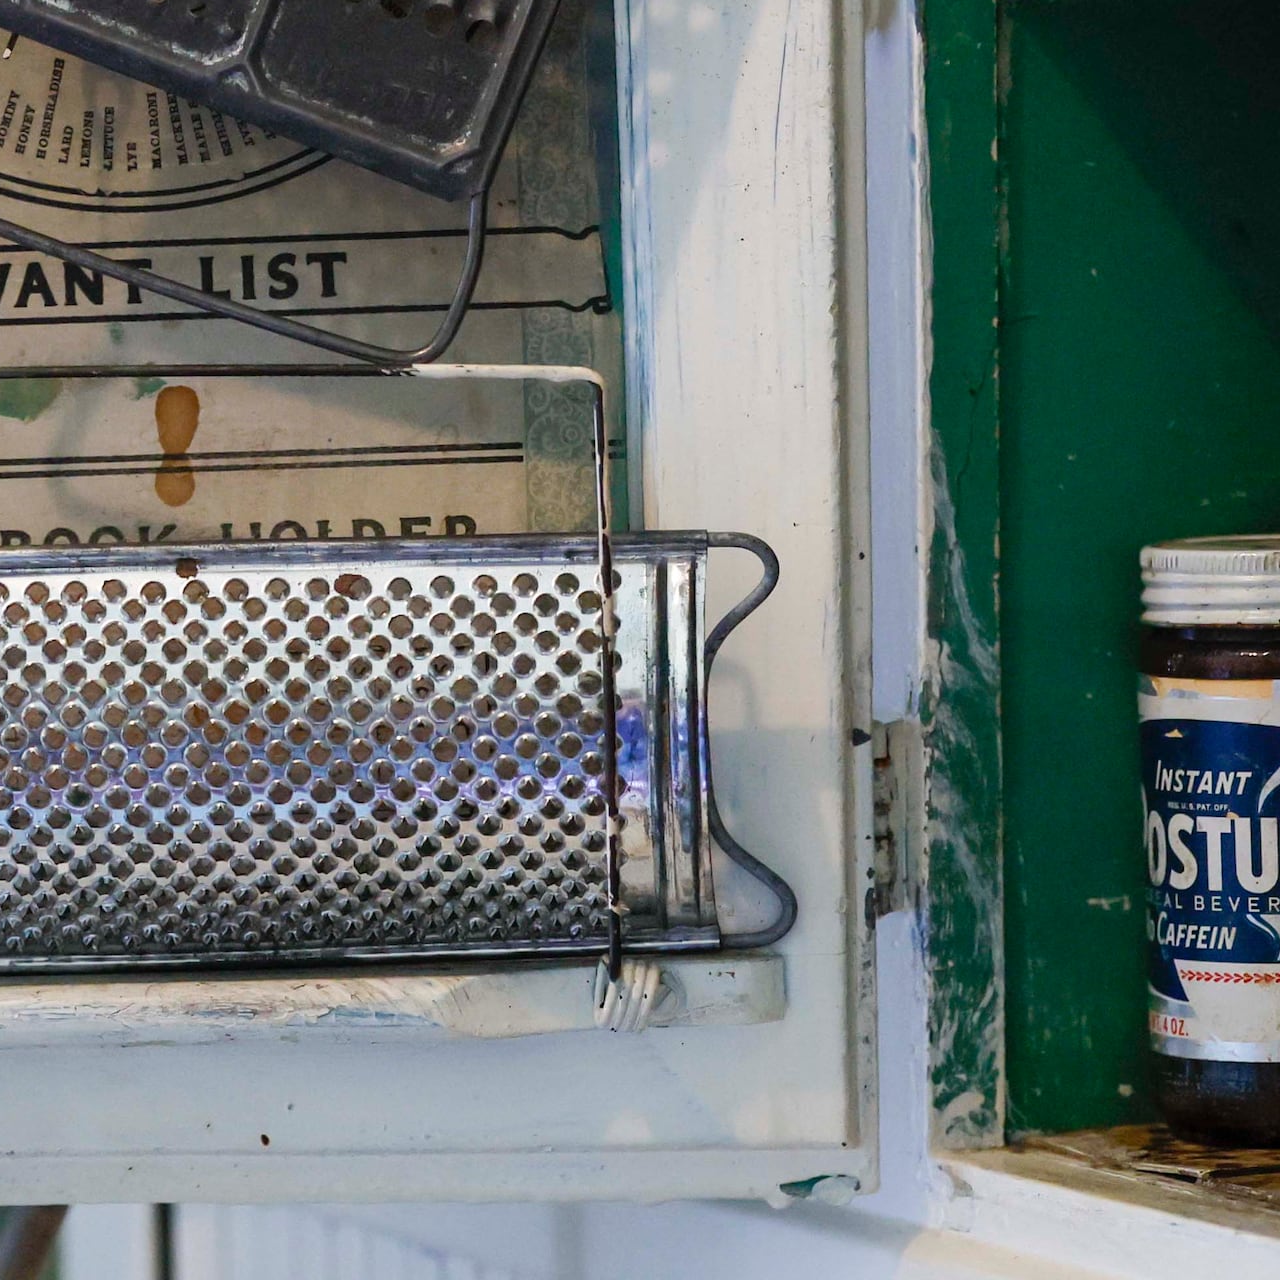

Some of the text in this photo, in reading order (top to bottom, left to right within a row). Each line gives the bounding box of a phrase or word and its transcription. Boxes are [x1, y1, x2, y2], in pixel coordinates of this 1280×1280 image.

[15, 104, 37, 156] HONEY
[36, 57, 66, 160] HORSERADISH
[146, 92, 162, 170] MACARONI
[58, 125, 75, 166] LARD
[80, 110, 95, 169] LEMONS
[103, 106, 116, 172] LETTUCE
[126, 142, 138, 172] LYE
[198, 251, 348, 302] LIST
[1155, 759, 1253, 796] INSTANT
[1156, 911, 1237, 951] CAFFEIN
[1170, 1017, 1190, 1038] OZ.
